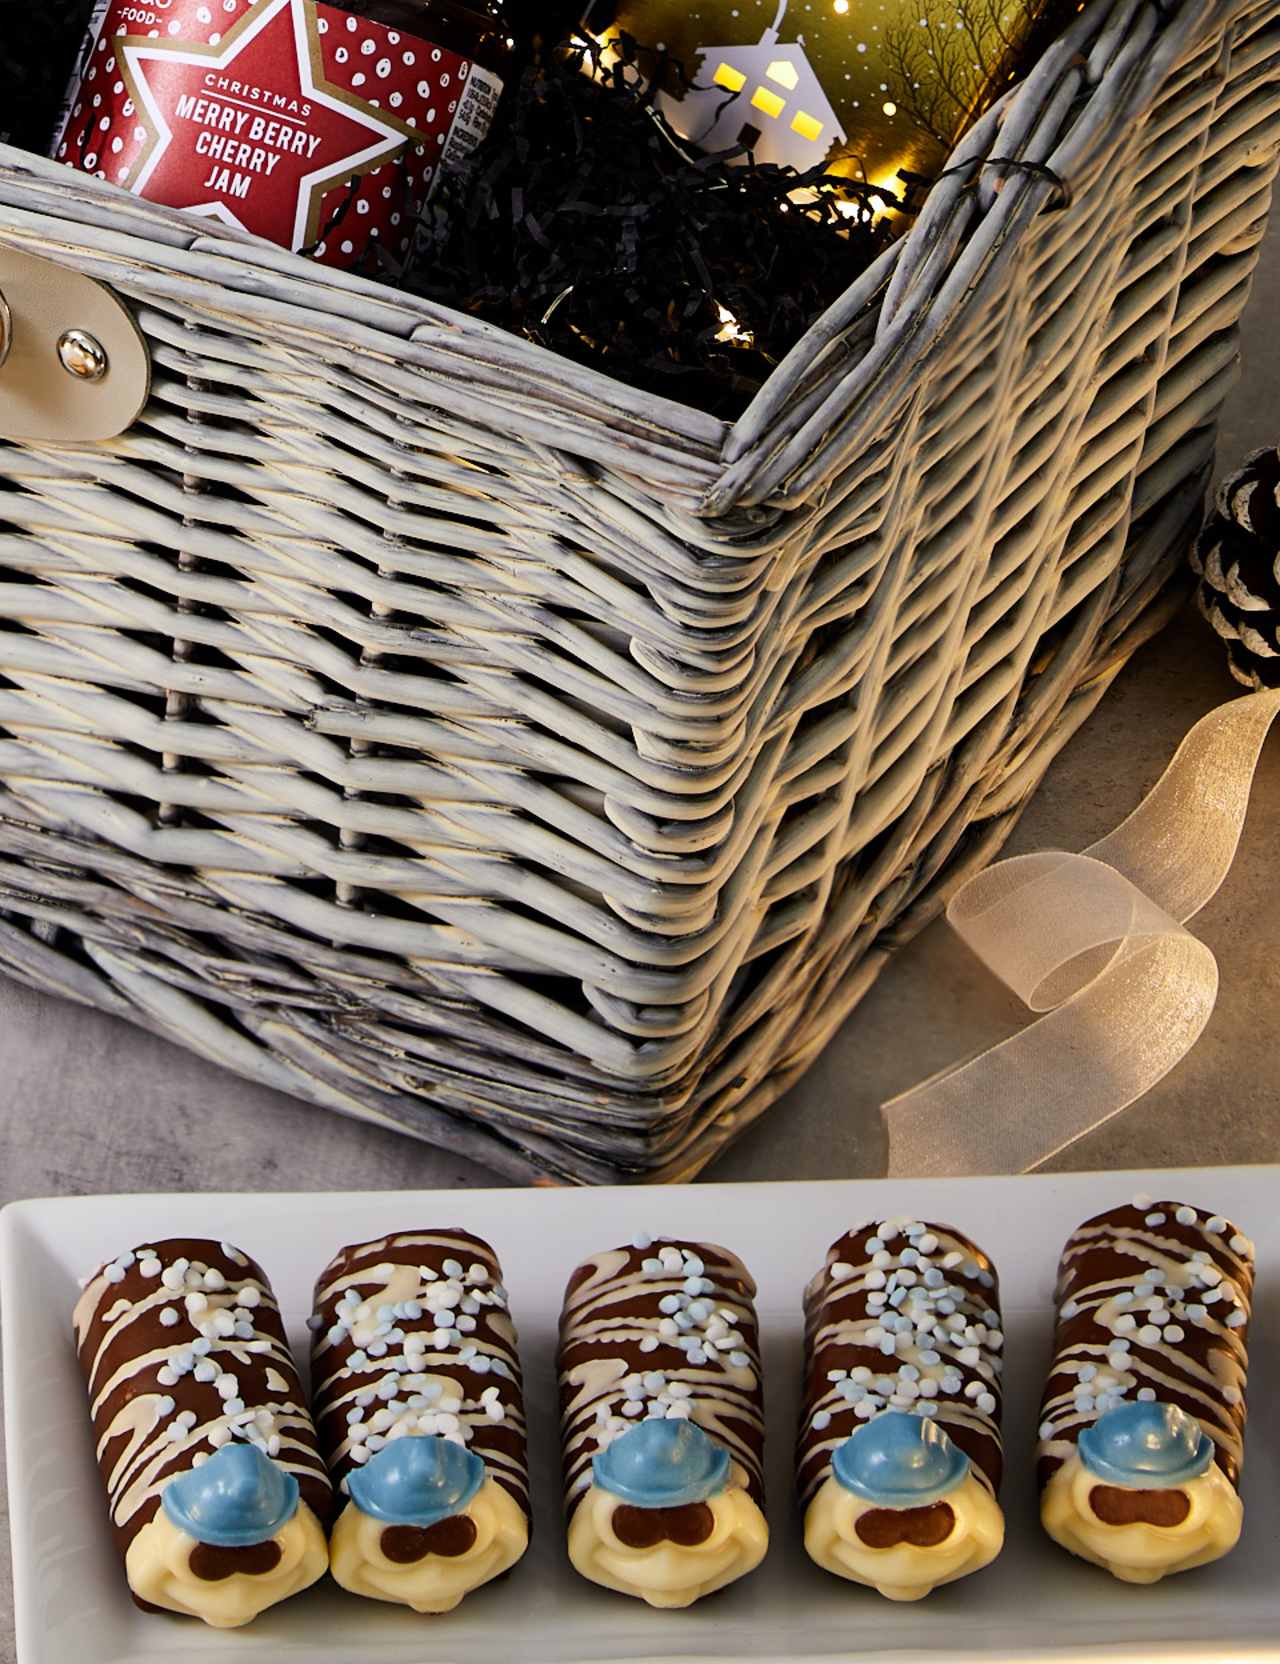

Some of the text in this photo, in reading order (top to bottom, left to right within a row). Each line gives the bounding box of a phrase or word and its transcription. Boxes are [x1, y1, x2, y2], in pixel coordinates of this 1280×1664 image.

[204, 73, 312, 117] CHRISTMAS
[175, 93, 322, 159] MERRY BERRY
[195, 131, 281, 176] CHERRY
[203, 165, 252, 200] JAM
